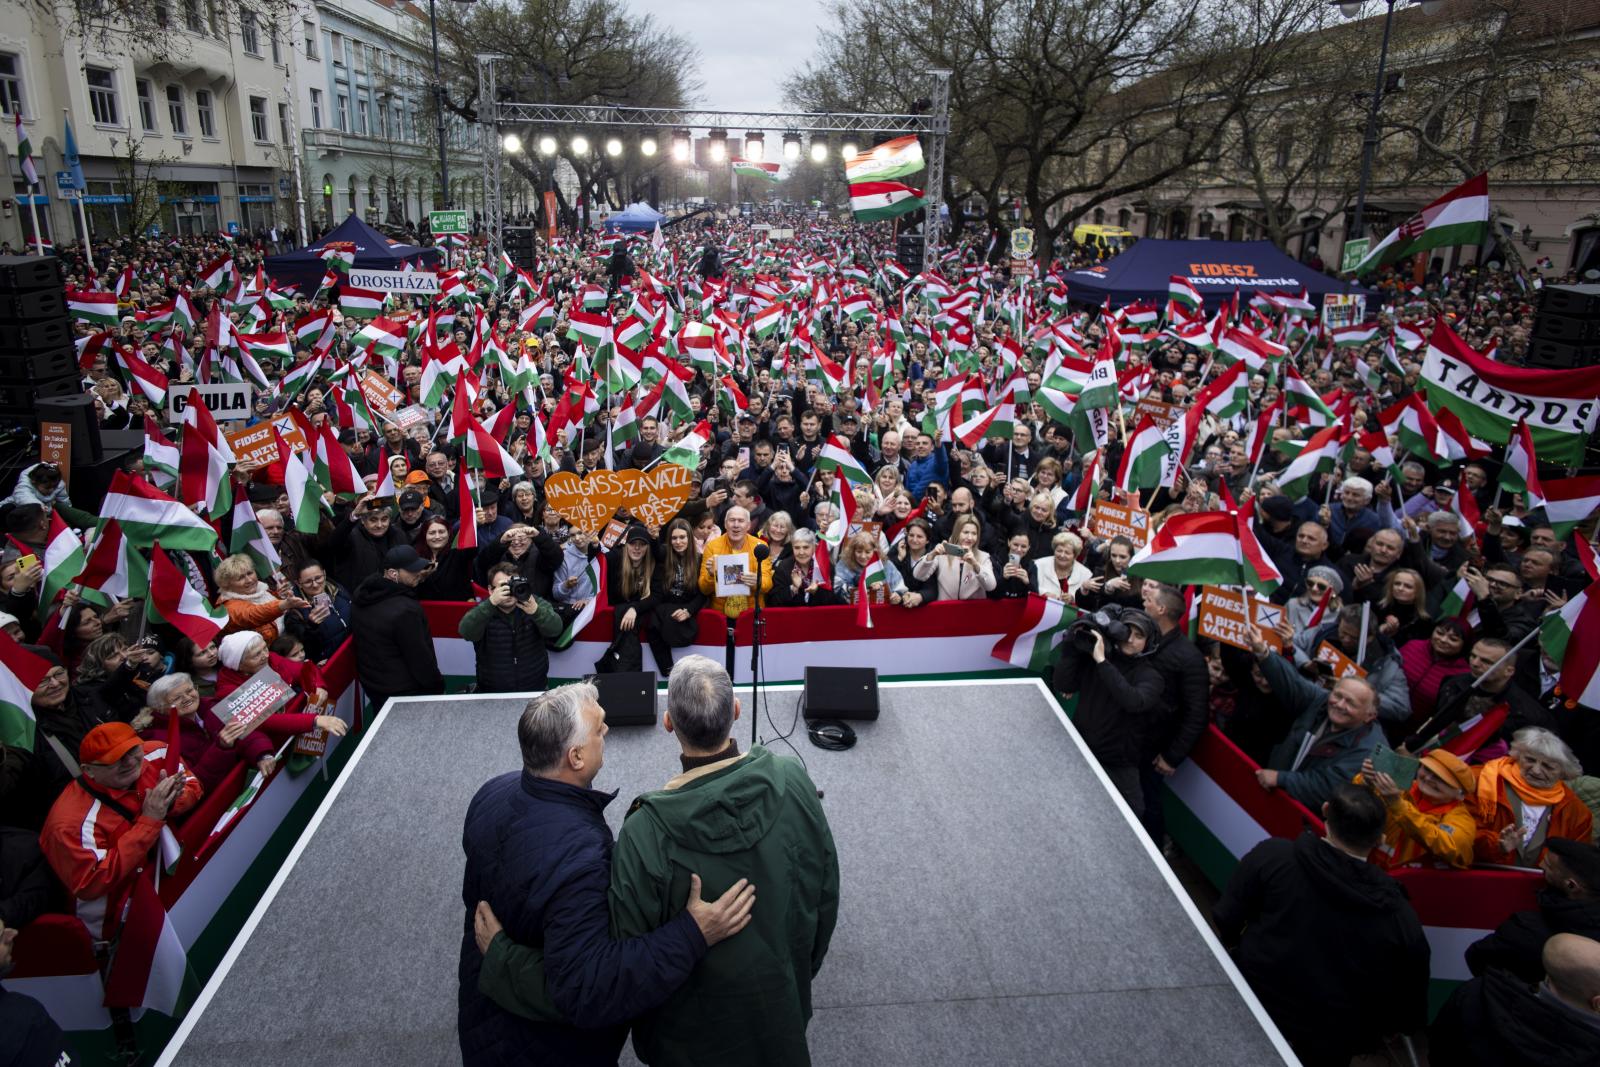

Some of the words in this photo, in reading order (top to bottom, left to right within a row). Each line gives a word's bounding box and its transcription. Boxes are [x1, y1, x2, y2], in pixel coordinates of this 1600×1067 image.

[1190, 263, 1259, 277] FIDESZ
[350, 274, 435, 290] OROSHÁZA
[1187, 277, 1226, 285] IZTOS
[1227, 276, 1299, 286] VÁLASZTÁS
[173, 392, 247, 413] GULA
[234, 428, 271, 449] FIDESZ
[242, 453, 252, 461] A
[545, 473, 623, 498] HALLGASS
[582, 497, 591, 507] A
[648, 493, 658, 504] A
[1098, 505, 1127, 520] FIDESZ
[1104, 520, 1135, 536] BIZTOS
[1203, 612, 1214, 624] A
[1215, 615, 1245, 633] BIZT
